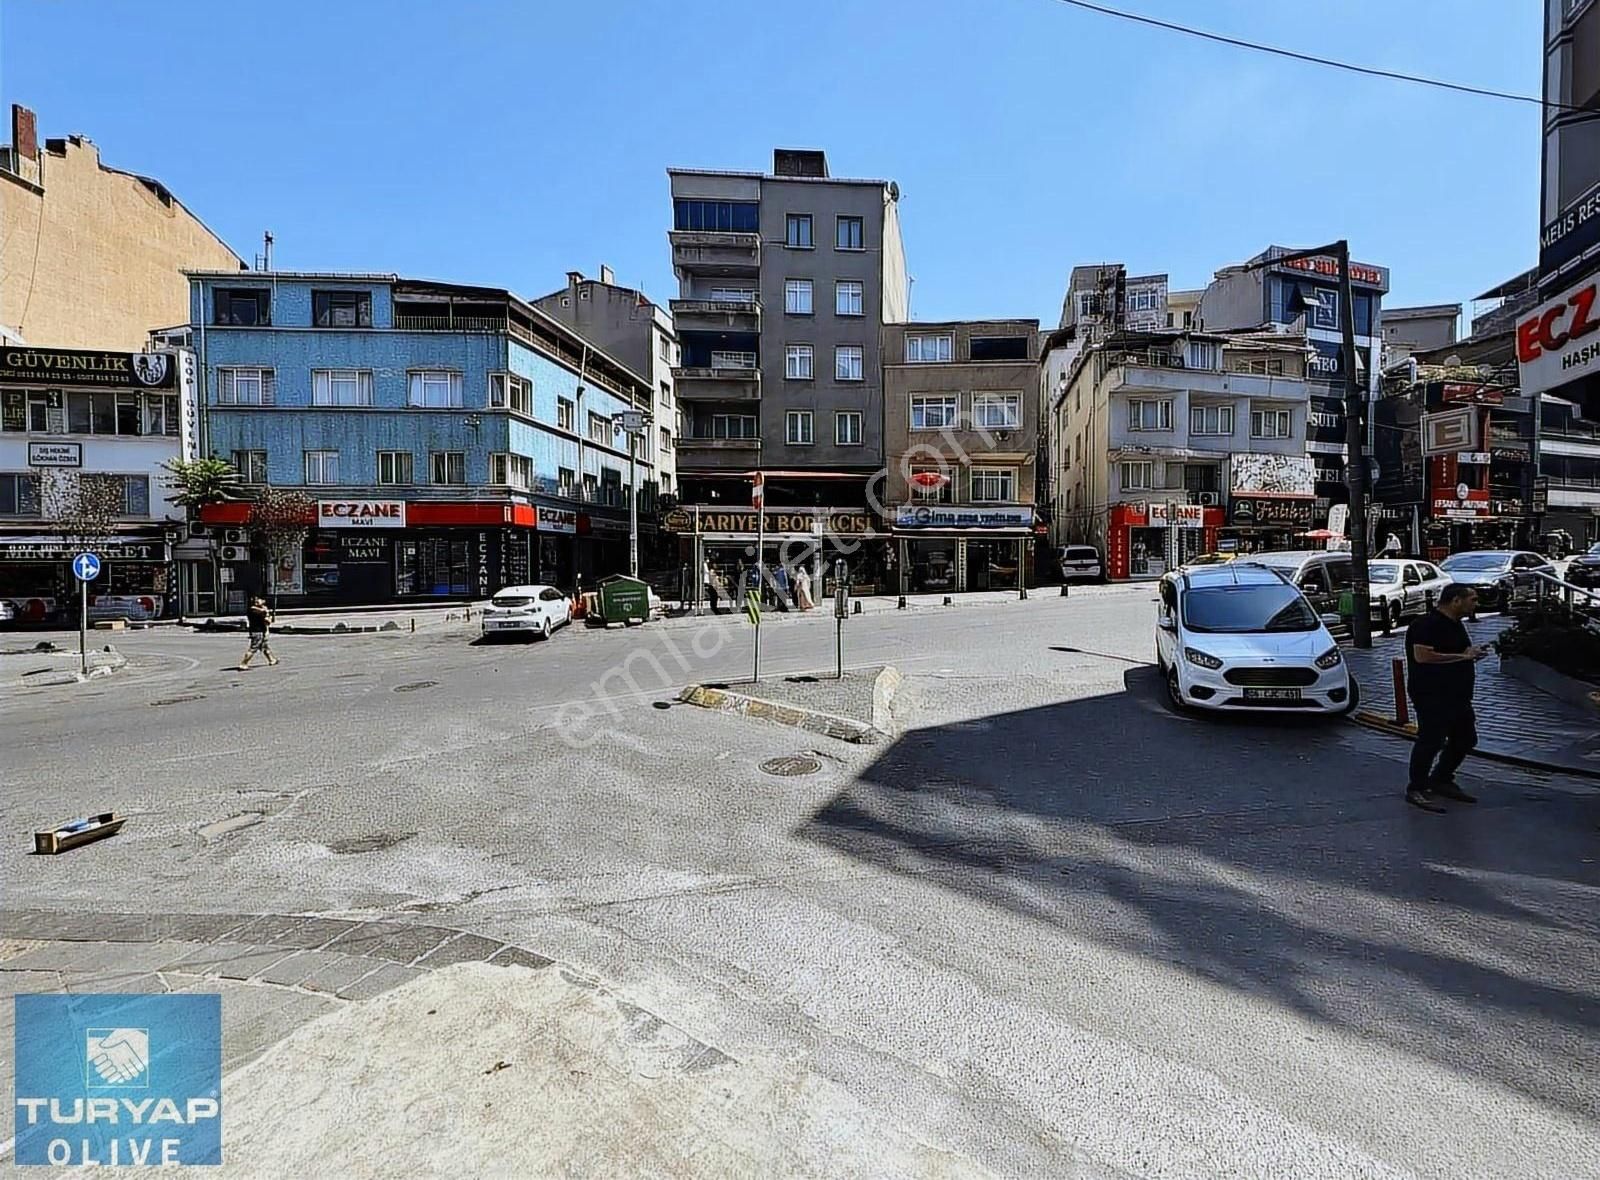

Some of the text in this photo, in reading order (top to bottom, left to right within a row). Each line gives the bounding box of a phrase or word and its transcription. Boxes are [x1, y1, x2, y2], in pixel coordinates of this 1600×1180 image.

[6, 350, 129, 372] GÜVENLİK
[1562, 341, 1600, 370] HAŞH
[1312, 357, 1338, 372] NEO
[1311, 412, 1338, 427] SUIT
[321, 503, 401, 518] ECZANE
[540, 508, 576, 524] ECZANE
[1152, 506, 1201, 519] ECANE
[693, 514, 769, 531] SARIYER
[341, 538, 389, 547] ECZANE
[478, 532, 488, 596] ECZANE
[500, 532, 508, 586] ECZAN
